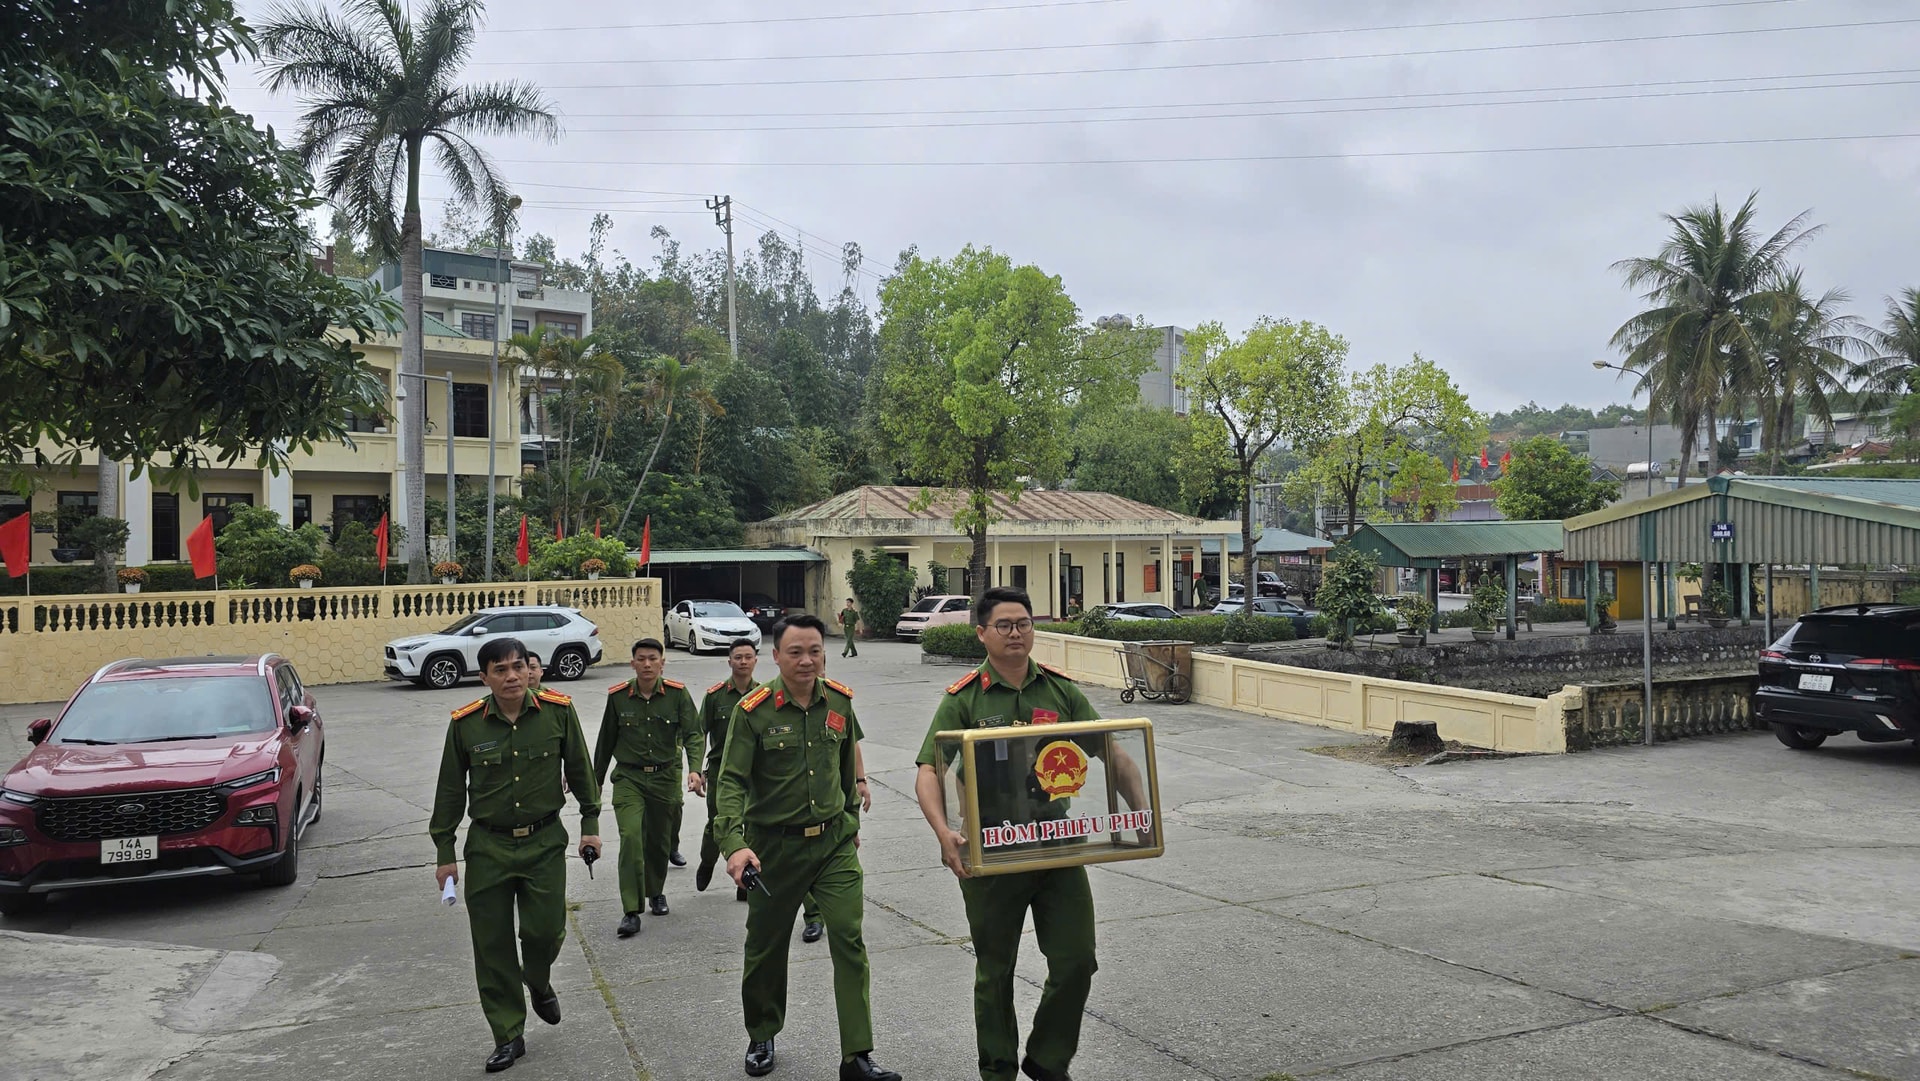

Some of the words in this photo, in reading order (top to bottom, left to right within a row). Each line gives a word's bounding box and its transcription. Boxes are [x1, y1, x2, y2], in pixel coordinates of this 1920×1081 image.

[983, 820, 1037, 847] HÒM
[1040, 812, 1105, 841] PHIẾU
[1109, 810, 1153, 834] PHỤ
[119, 838, 142, 850] 14A
[107, 849, 152, 863] 799.89
